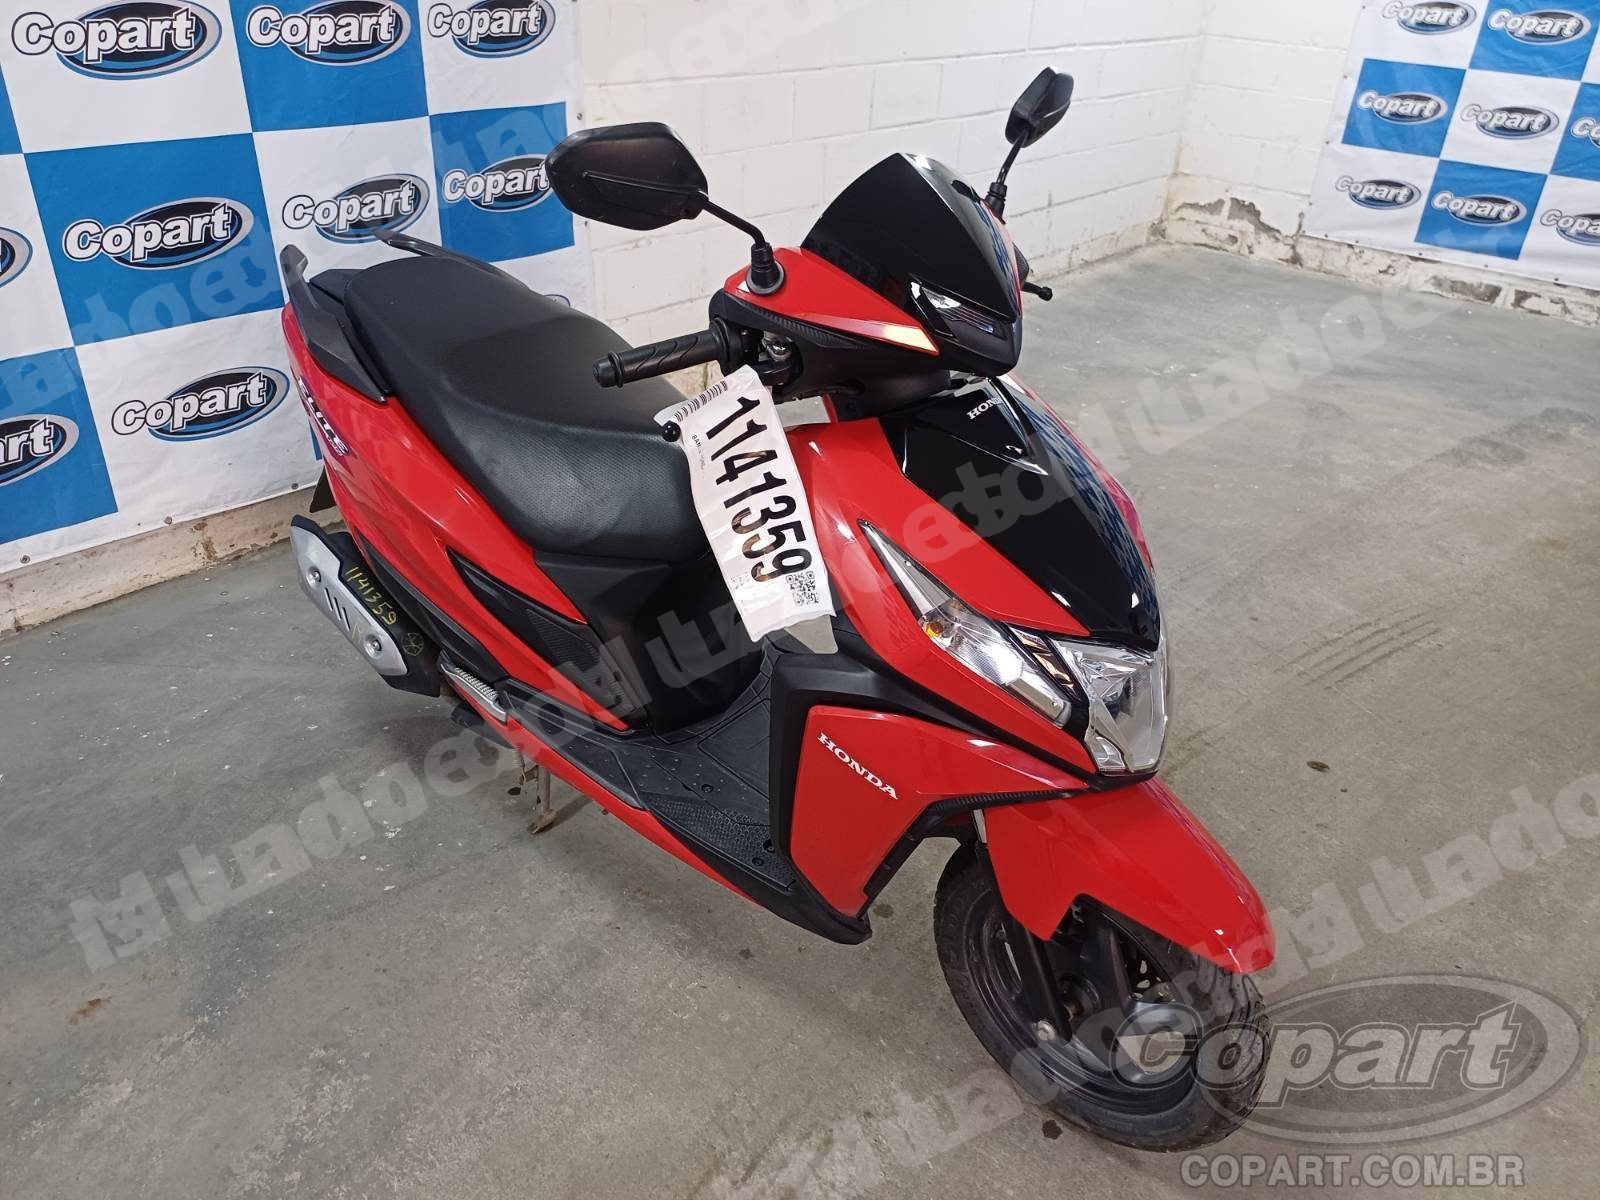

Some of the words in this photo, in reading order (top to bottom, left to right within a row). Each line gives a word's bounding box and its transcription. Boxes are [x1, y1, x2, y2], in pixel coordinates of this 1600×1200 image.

[12, 8, 196, 63] Copart
[247, 4, 395, 54] Copart
[428, 2, 542, 44] Copart
[1382, 1, 1467, 27] Copart
[1488, 10, 1581, 37] Copart
[1357, 92, 1440, 117] Copart
[1461, 104, 1550, 131] Copart
[443, 163, 549, 206] Copart
[1335, 176, 1411, 203] Copart
[1431, 192, 1519, 219] Copart
[282, 181, 415, 233] Copart
[1540, 210, 1600, 236] Copa
[63, 204, 232, 262] Copart
[112, 372, 267, 436] Copart
[706, 396, 813, 583] 1141359
[345, 566, 397, 625] 1141359
[817, 732, 898, 800] HONDA
